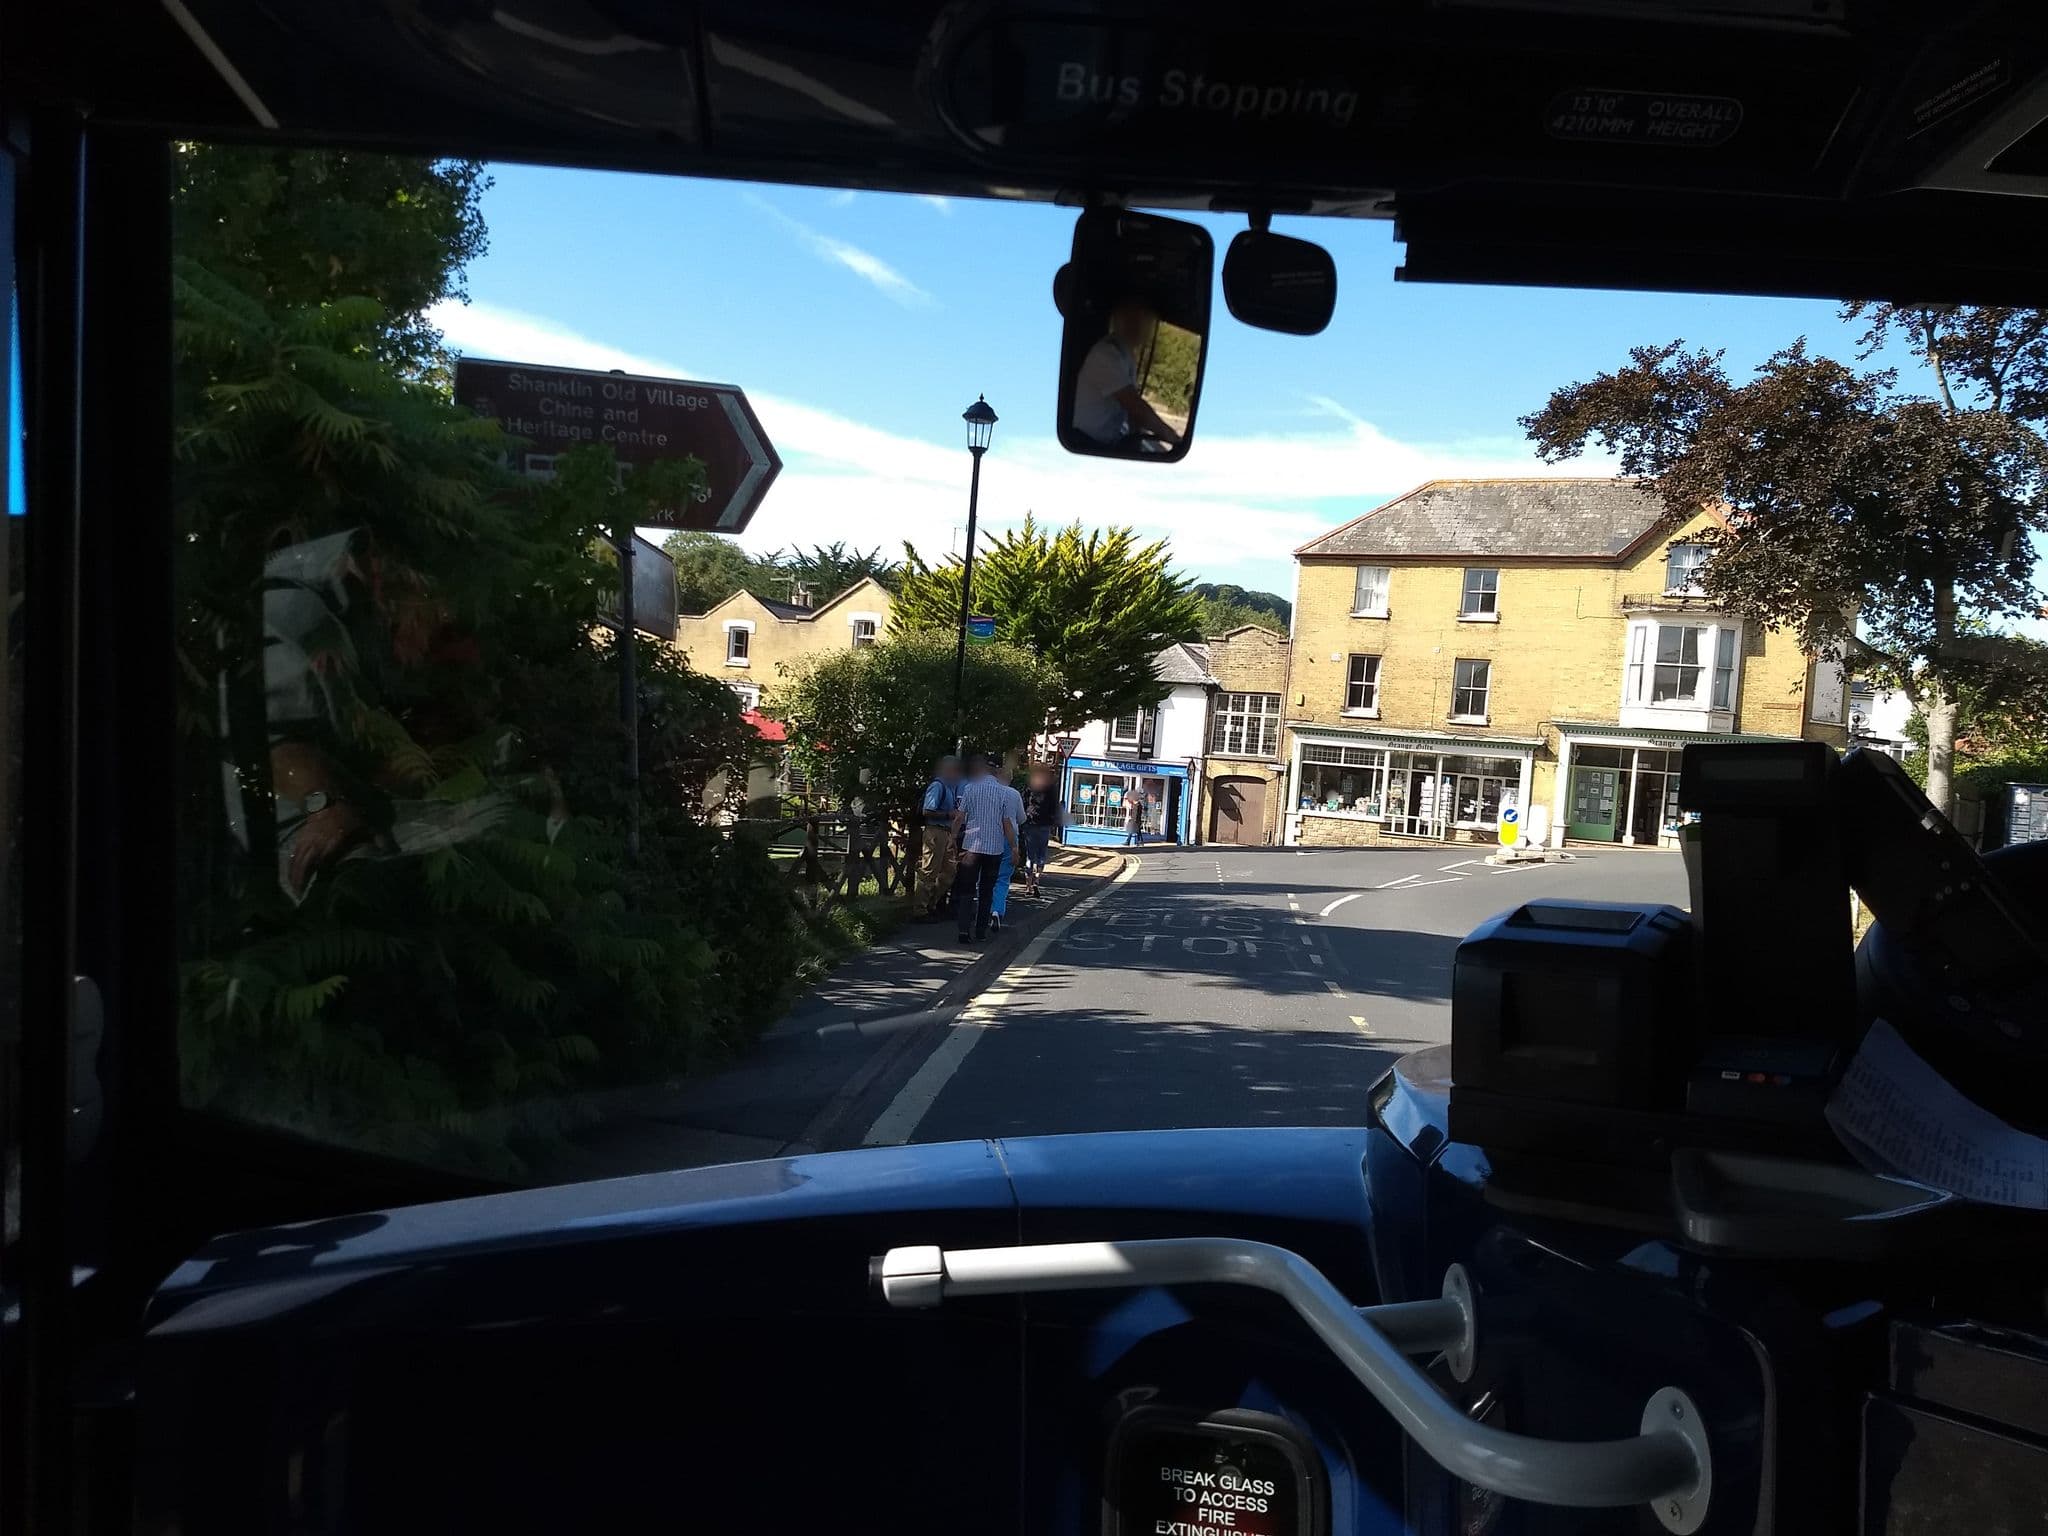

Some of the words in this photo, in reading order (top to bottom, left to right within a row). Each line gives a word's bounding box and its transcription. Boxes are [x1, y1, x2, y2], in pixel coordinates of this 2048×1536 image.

[1056, 61, 1142, 106] Bus
[1159, 69, 1360, 128] Stopping
[1647, 100, 1737, 121] OVERALL
[1647, 119, 1722, 139] HEIGHT
[508, 373, 593, 399] Shanklin
[602, 383, 637, 403] Old
[646, 387, 710, 411] Village
[539, 398, 595, 419] Chine
[604, 407, 639, 424] and
[506, 416, 594, 442] Heritage
[602, 425, 668, 447] Centre
[1091, 759, 1105, 768] OLD
[1105, 761, 1136, 771] VILLAGE
[1136, 764, 1157, 773] GIFTS
[1105, 911, 1262, 932] BUS
[1061, 932, 1294, 957] STOP
[1160, 1466, 1217, 1488] BREAK
[1219, 1475, 1276, 1497] GLASS
[1172, 1487, 1197, 1503] TO
[1199, 1491, 1269, 1514] ACCESS
[1197, 1508, 1237, 1527] FIRE
